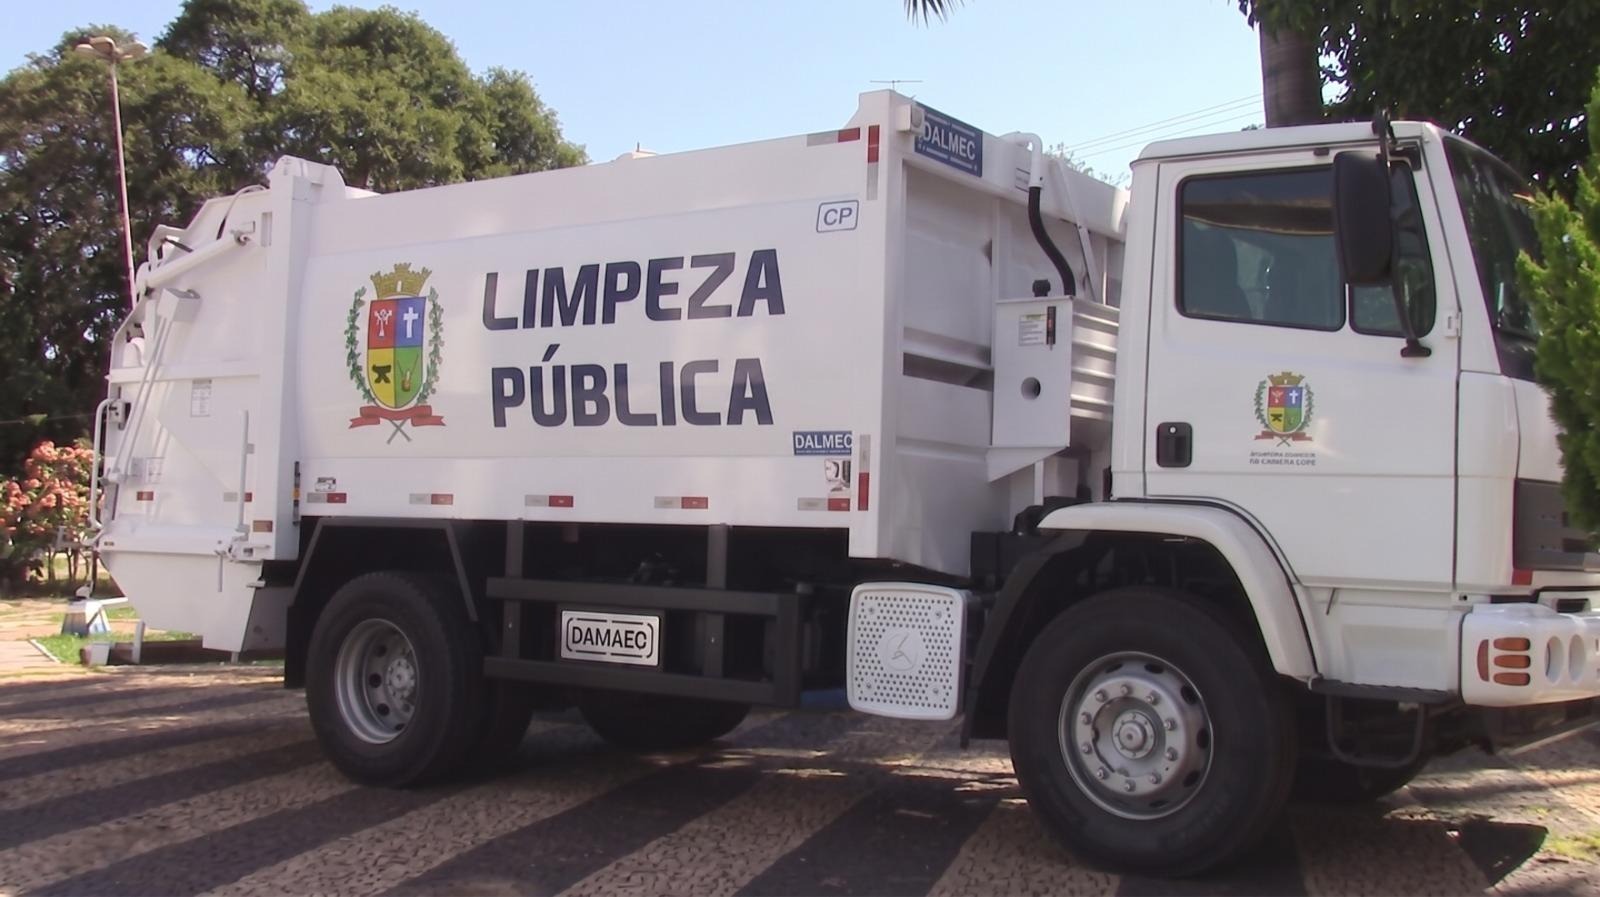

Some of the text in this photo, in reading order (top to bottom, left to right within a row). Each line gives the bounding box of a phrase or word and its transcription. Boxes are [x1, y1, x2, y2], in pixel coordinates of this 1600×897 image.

[922, 120, 976, 160] DALMEC
[823, 207, 853, 226] CP
[482, 248, 786, 331] LIMPEZA
[491, 343, 774, 428] PÚBLICA
[572, 626, 647, 649] DAMAEC
